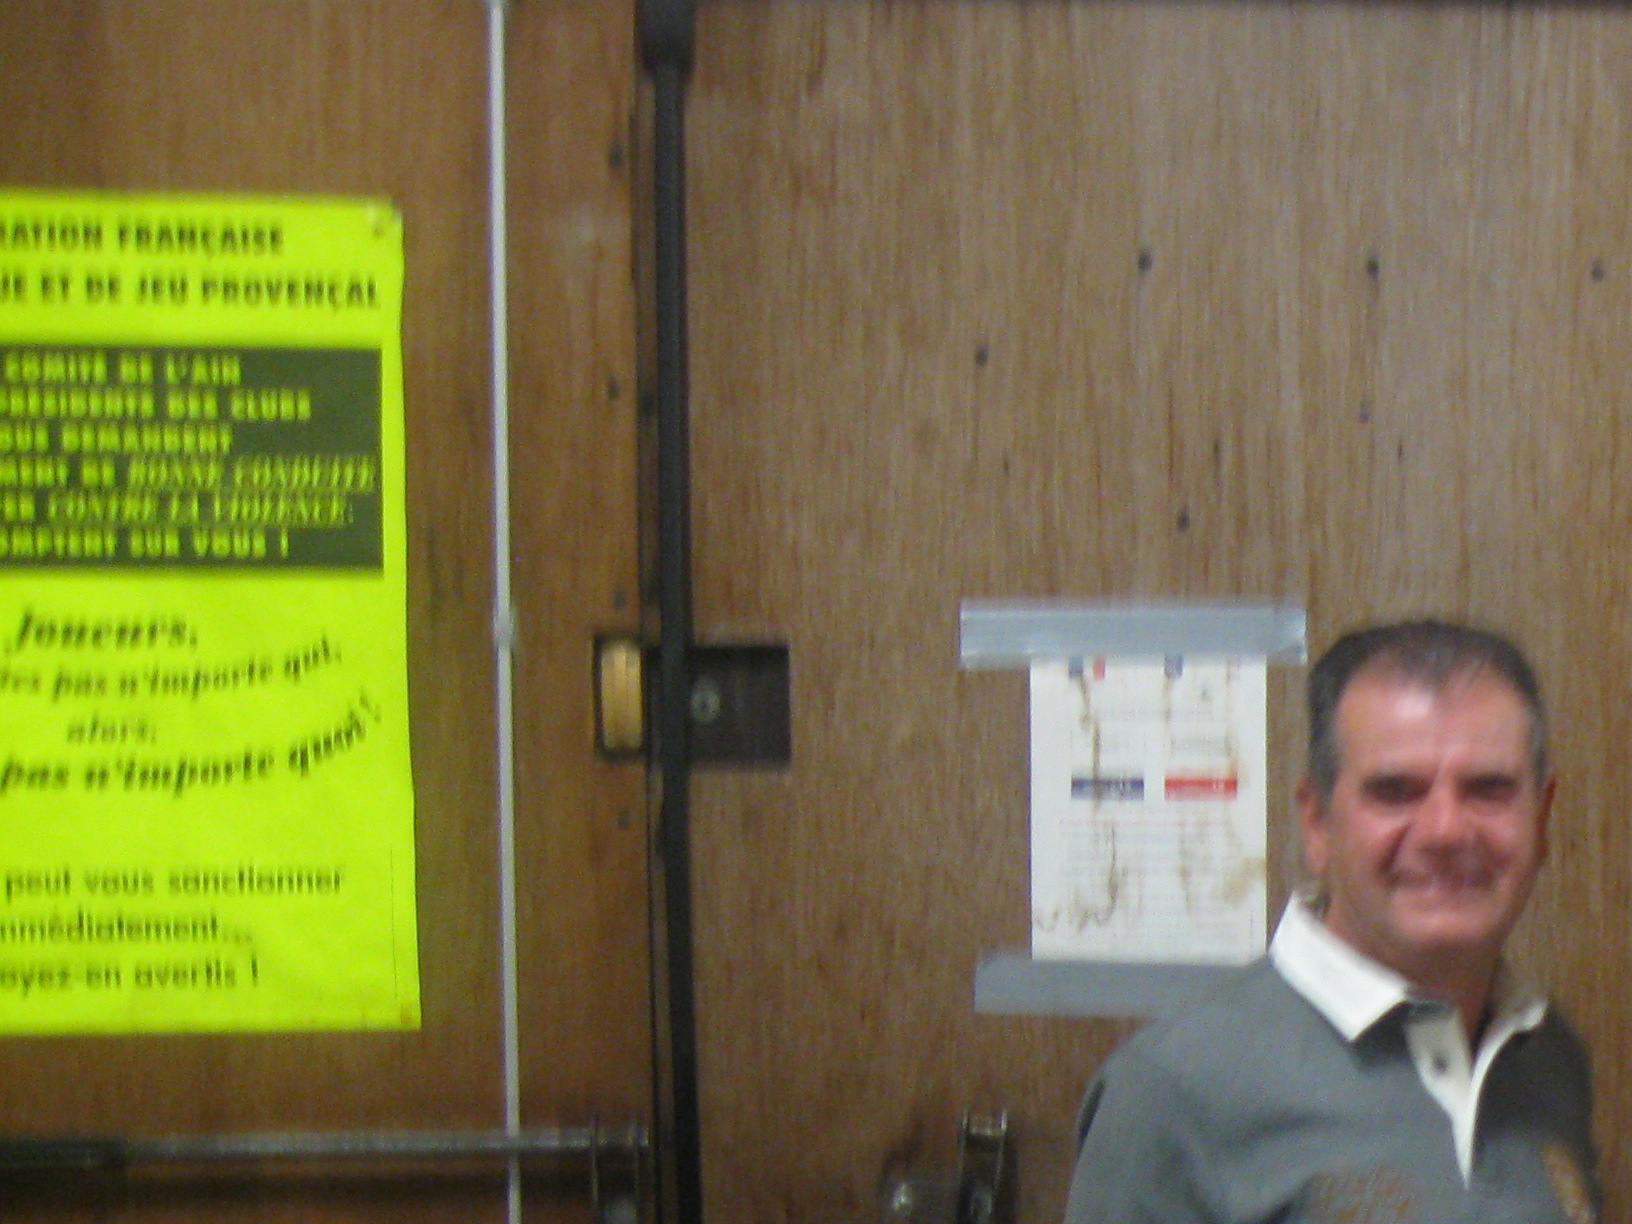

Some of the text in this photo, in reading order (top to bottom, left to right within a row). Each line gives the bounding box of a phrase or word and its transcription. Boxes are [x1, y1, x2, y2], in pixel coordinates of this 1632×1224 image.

[117, 221, 284, 258] FRANÇAISE
[41, 273, 71, 305] ET
[86, 273, 120, 305] DE
[139, 273, 188, 306] JEU
[202, 273, 377, 310] PROVENÇAL
[119, 353, 153, 386] DE
[164, 353, 241, 387] L'AIN
[167, 388, 218, 421] DES
[230, 388, 311, 423] CLUBS
[62, 421, 232, 455] DEMANDENT
[81, 455, 115, 488] DE
[127, 455, 226, 489] BONNE
[234, 455, 376, 492] CONDUITE
[48, 491, 159, 524] CONTRE
[167, 491, 200, 524] LA
[131, 526, 180, 559] SUR
[193, 526, 266, 559] VOUS
[5, 608, 197, 652] Joueurs,
[53, 665, 107, 702] pas
[119, 657, 272, 700] n'importe
[84, 750, 273, 797] n'importe
[6, 861, 342, 900] peut vous sanctionner
[86, 964, 122, 989] en
[134, 957, 236, 989] avertis
